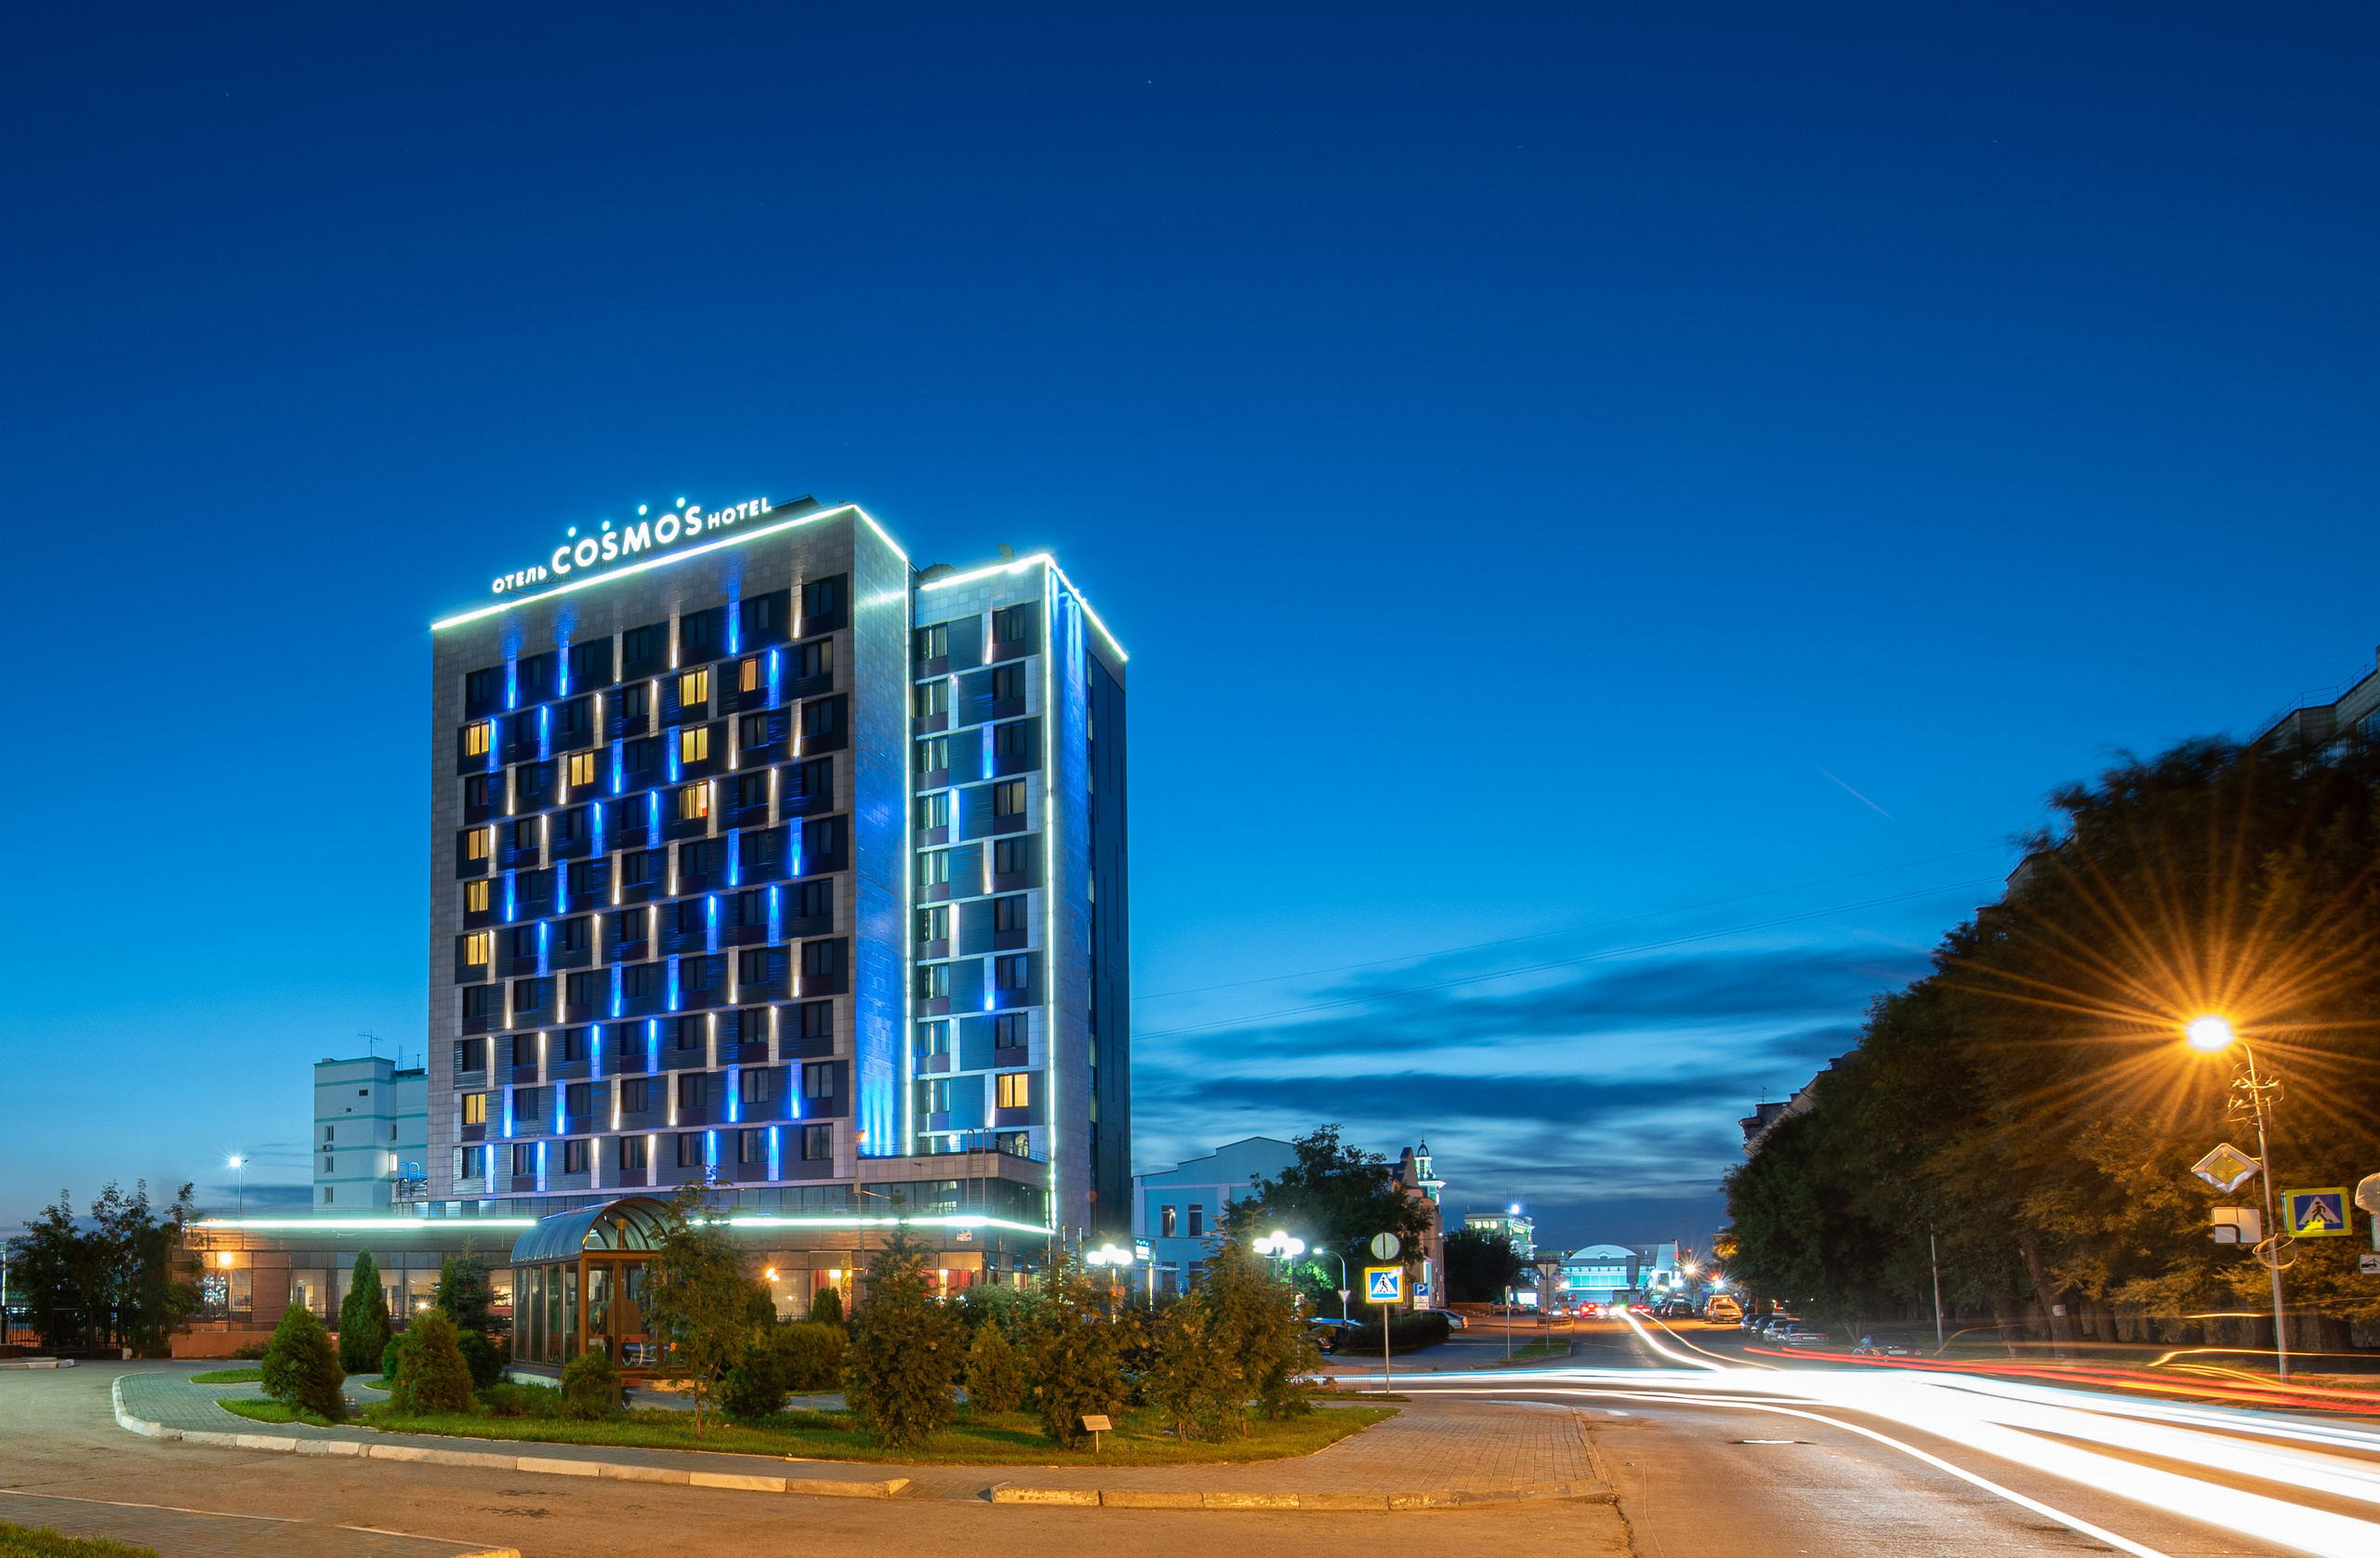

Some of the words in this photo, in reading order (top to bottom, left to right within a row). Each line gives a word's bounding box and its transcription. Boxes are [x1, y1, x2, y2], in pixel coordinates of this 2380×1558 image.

[492, 565, 548, 594] ОТЕЛЬ
[551, 506, 703, 574] COSMOS
[707, 497, 772, 530] HOTEL
[1417, 1284, 1425, 1295] P
